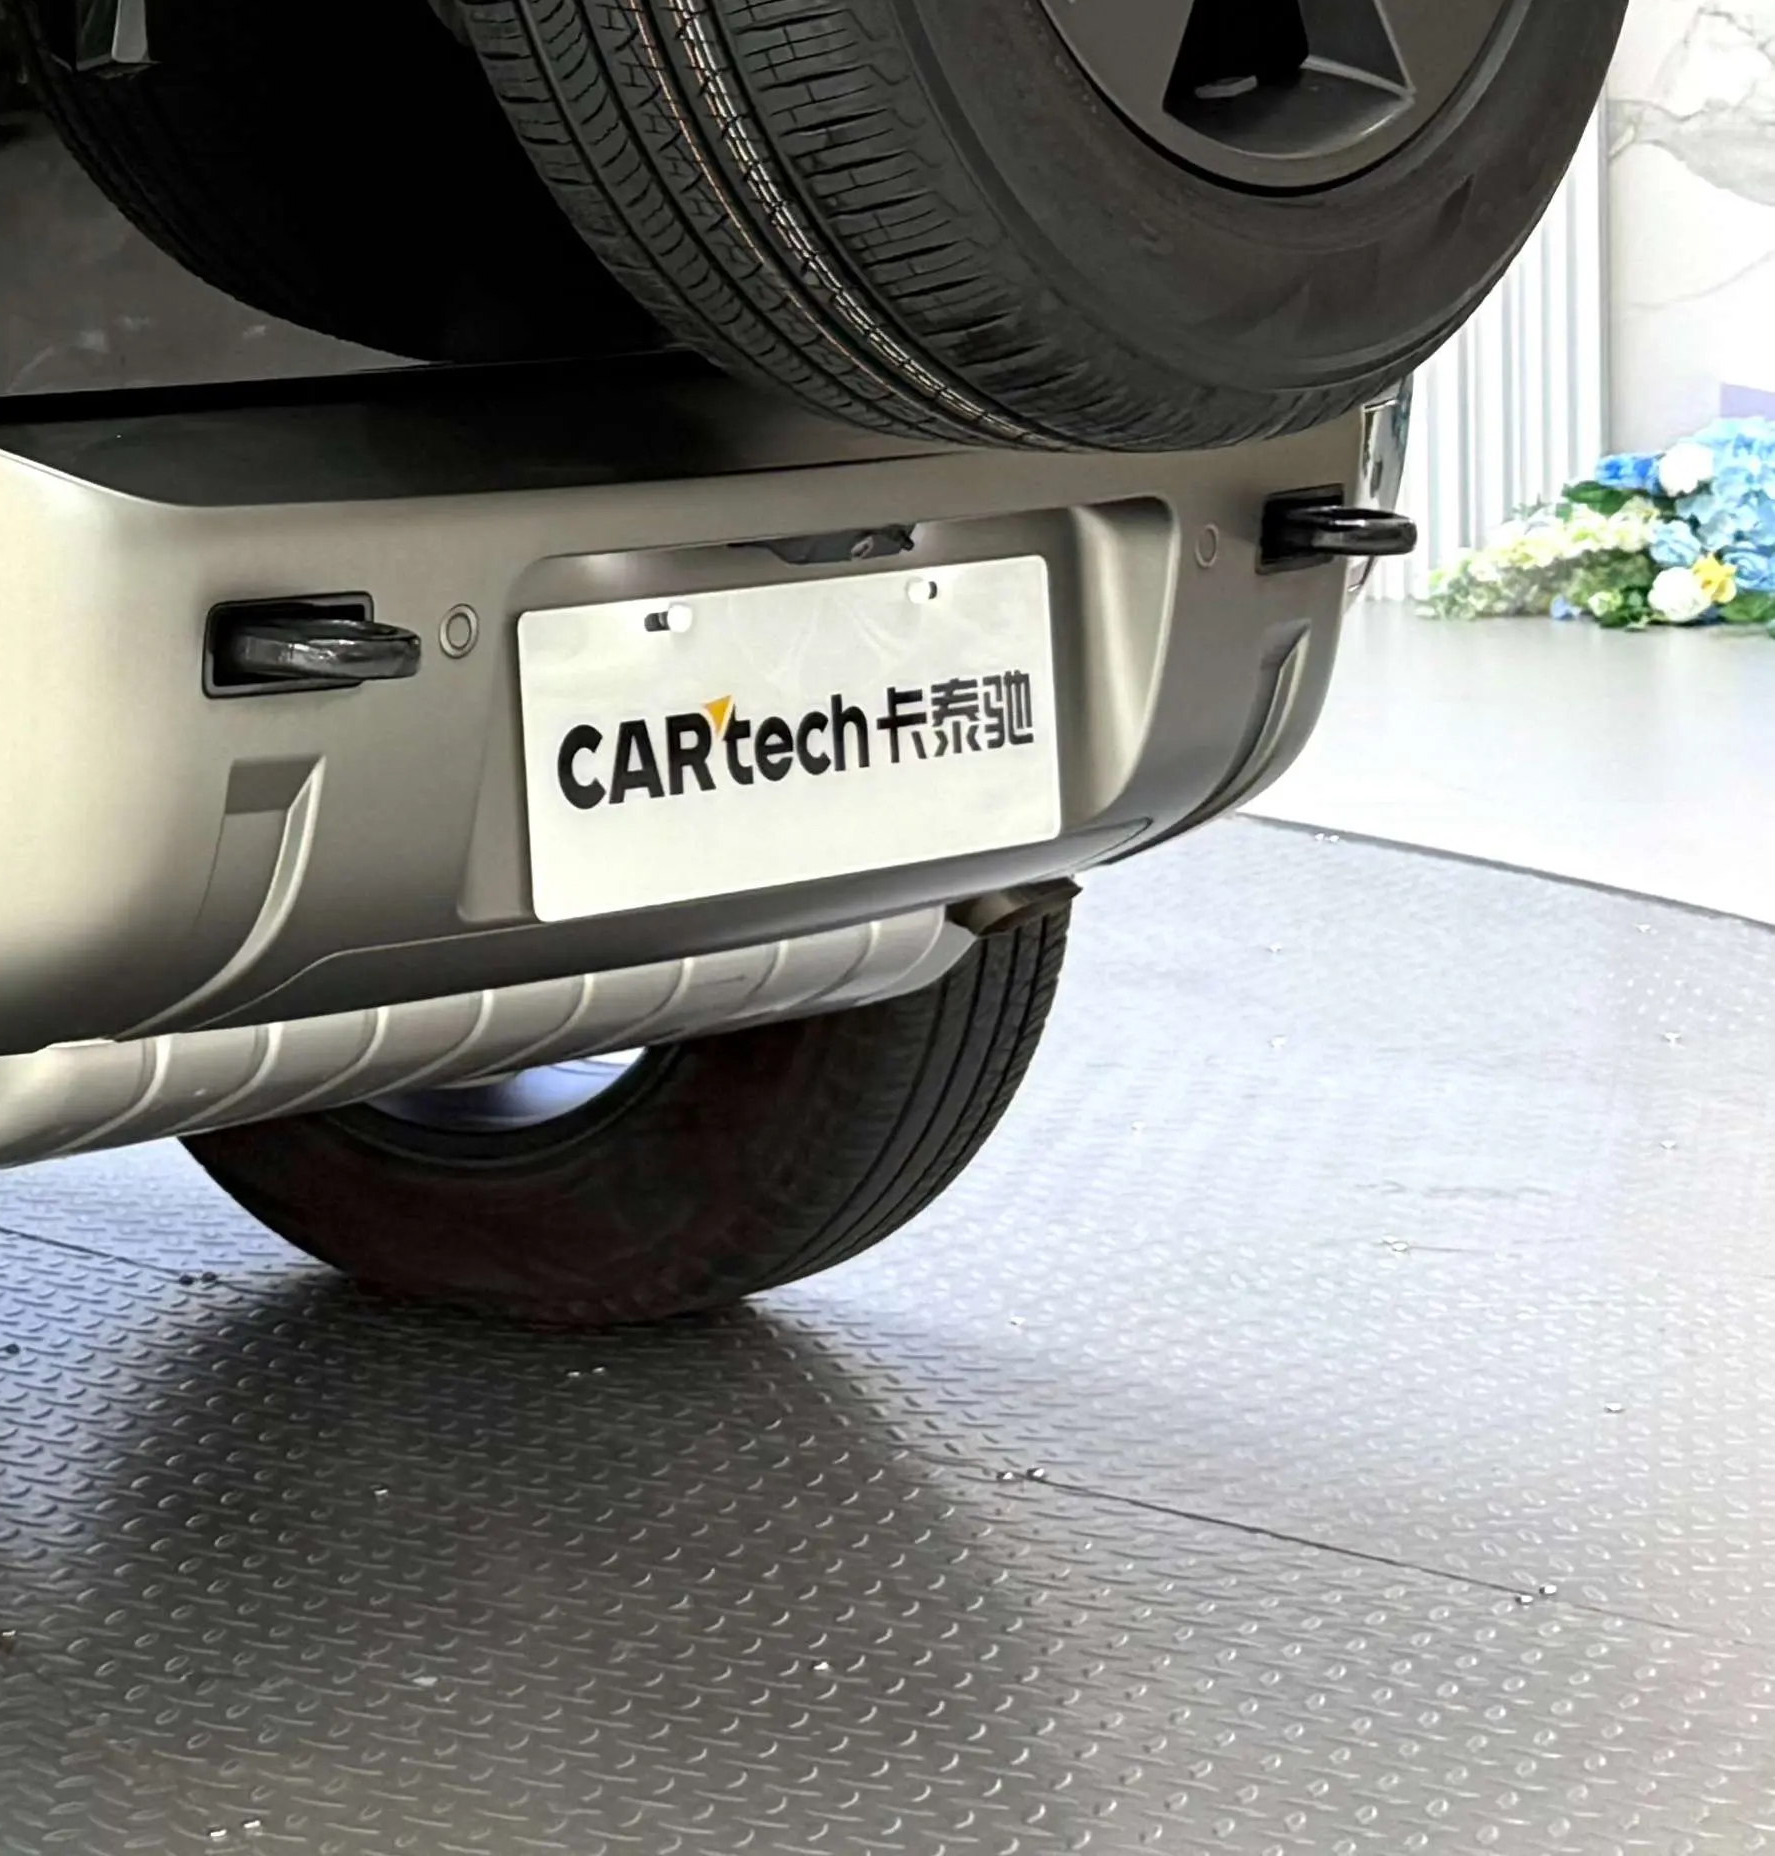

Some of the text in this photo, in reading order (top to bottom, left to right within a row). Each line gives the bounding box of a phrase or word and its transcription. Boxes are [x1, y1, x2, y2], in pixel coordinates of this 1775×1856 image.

[557, 670, 1035, 810] CARtech 卡泰驰
